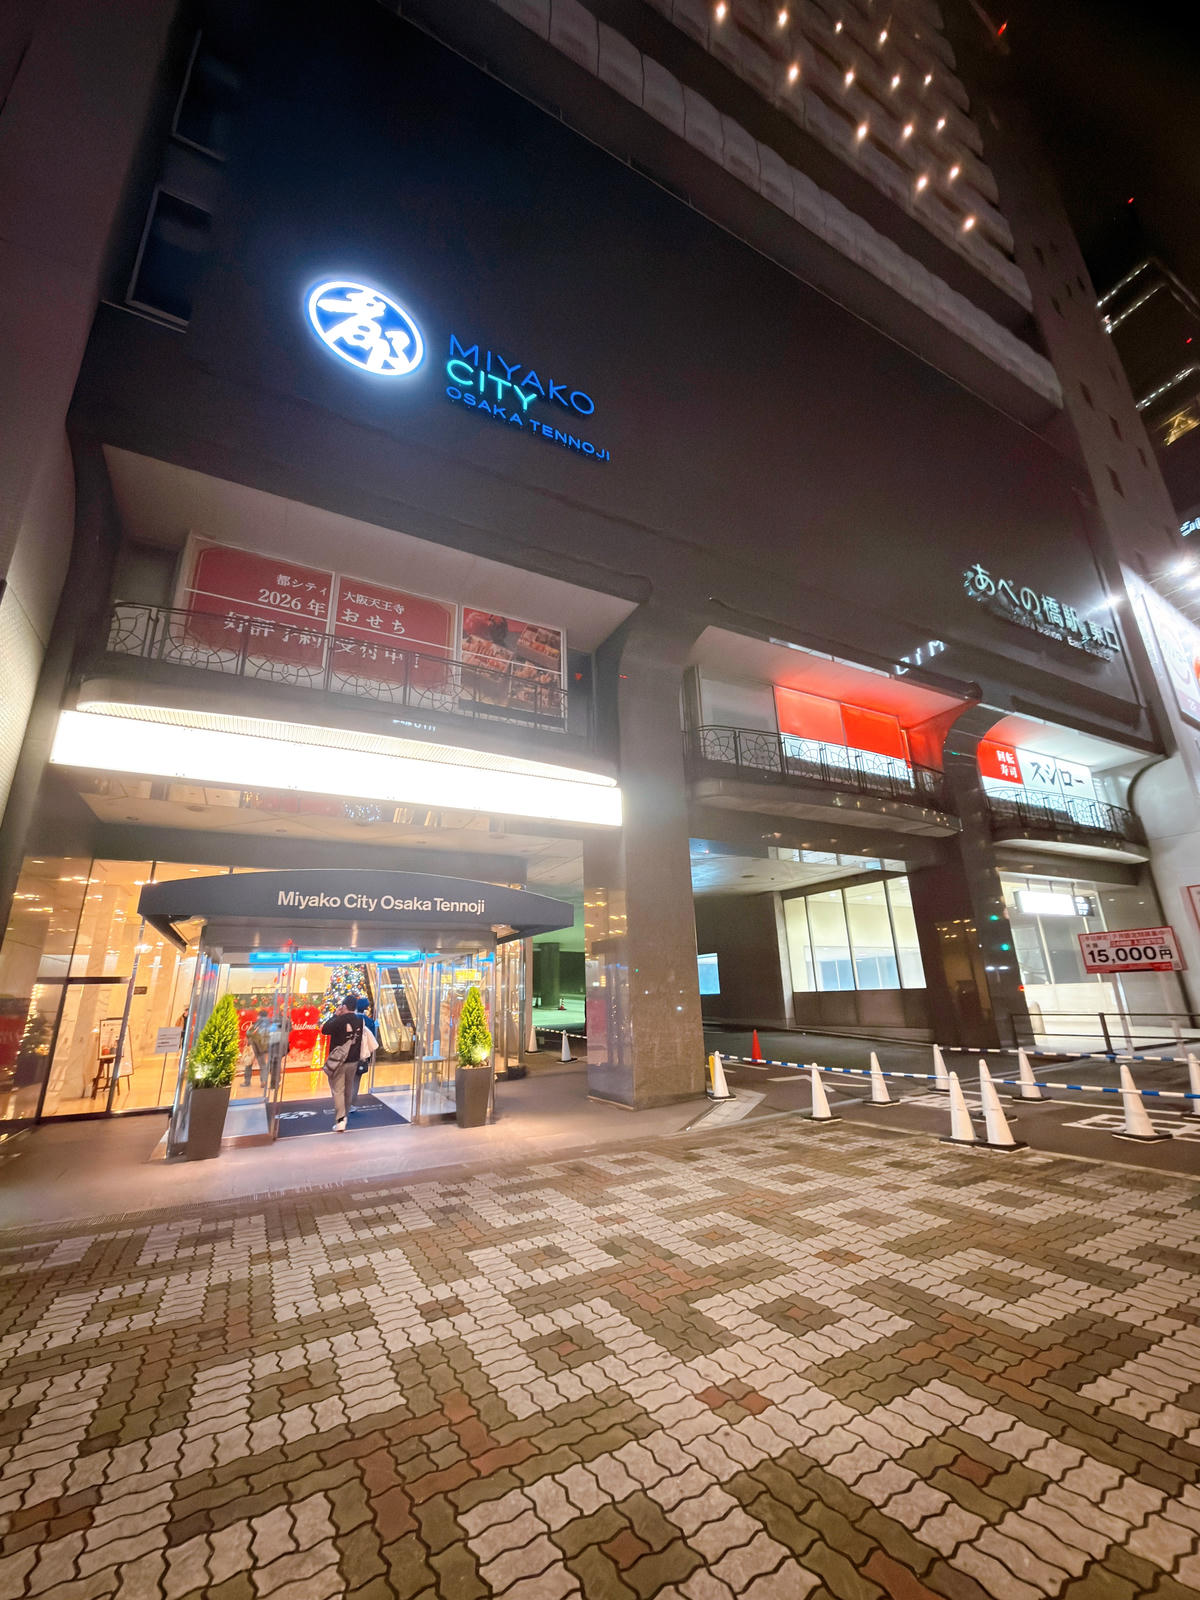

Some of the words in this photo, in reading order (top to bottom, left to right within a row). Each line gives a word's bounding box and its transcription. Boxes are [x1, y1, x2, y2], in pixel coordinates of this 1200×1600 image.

[446, 359, 538, 412] CITY
[449, 333, 595, 415] MIYAKO
[445, 386, 523, 427] OSAKA
[529, 418, 611, 462] TENNOJI
[276, 573, 328, 597] 都シティ
[343, 591, 405, 615] 大阪天王寺
[341, 607, 406, 635] おせち
[1030, 761, 1085, 788] スシロー
[277, 890, 341, 910] Miyako
[344, 893, 378, 912] City
[380, 895, 432, 911] Osaka
[433, 897, 485, 915] Tennoji
